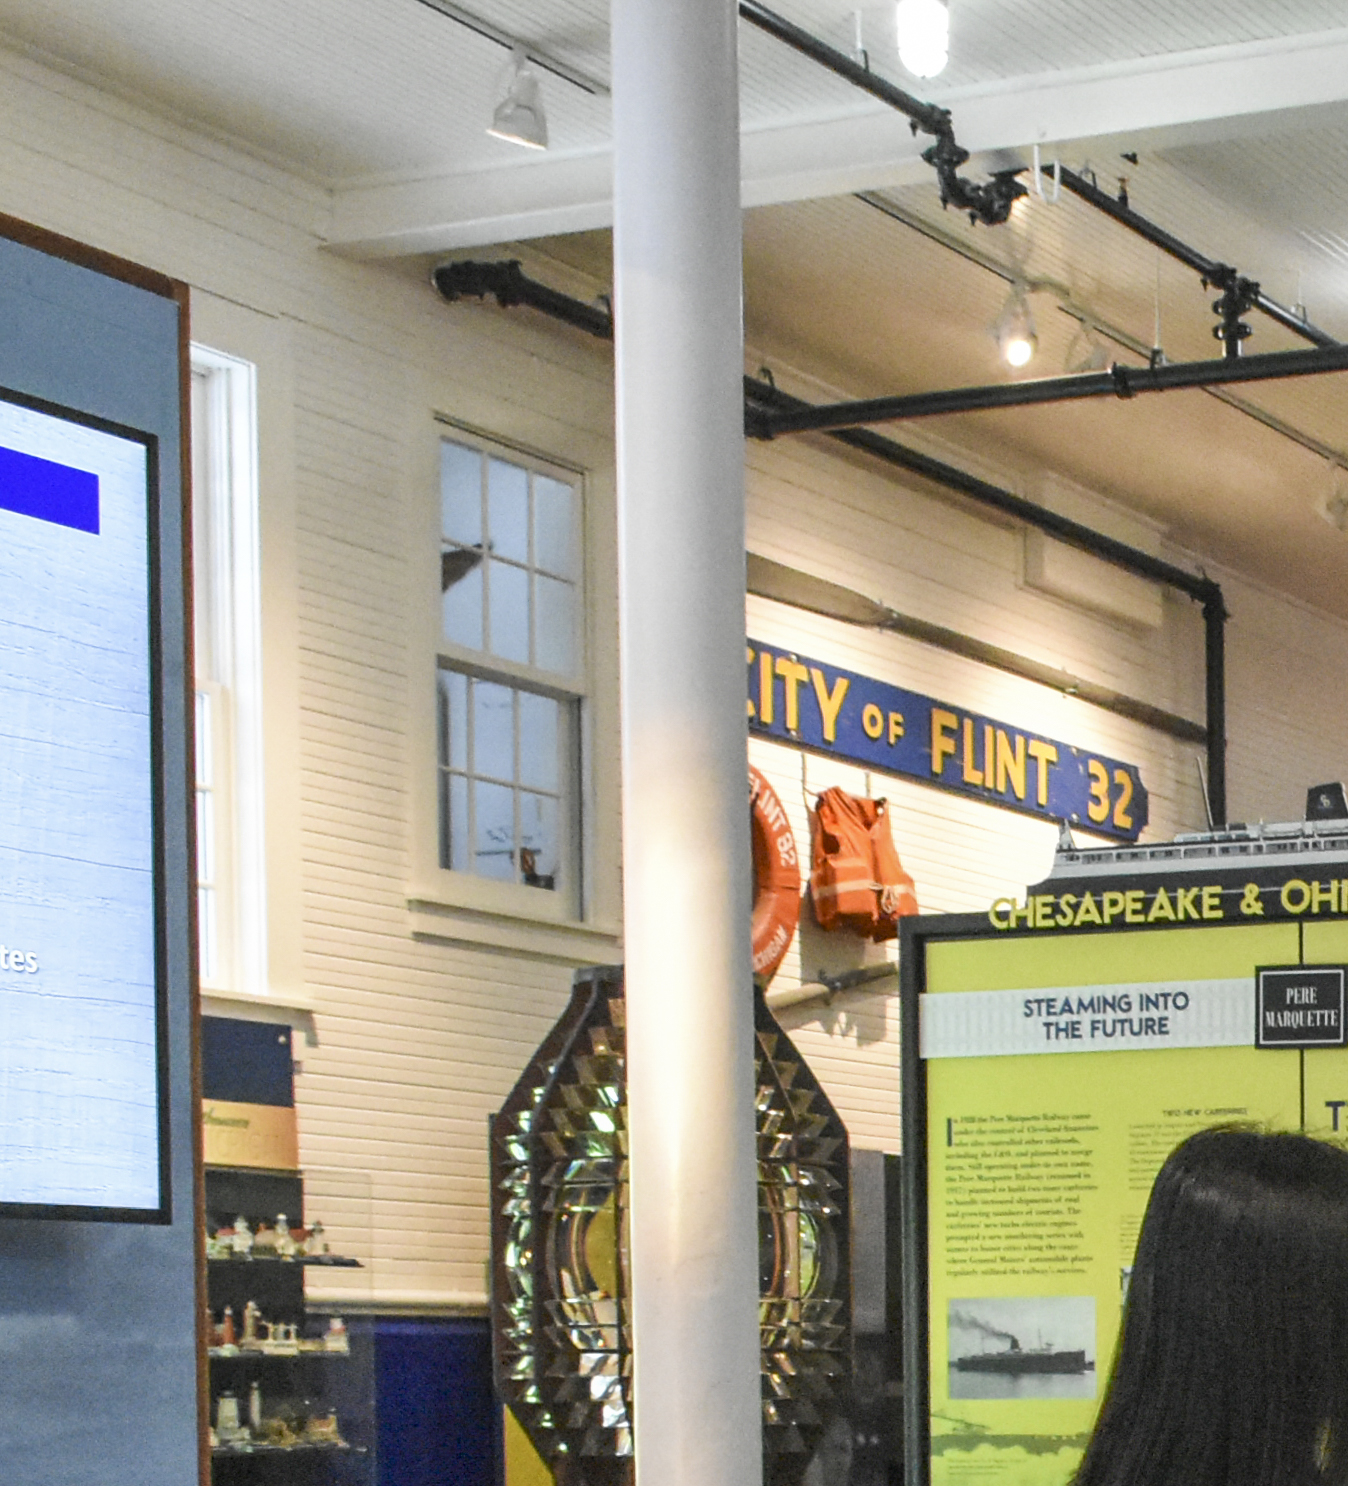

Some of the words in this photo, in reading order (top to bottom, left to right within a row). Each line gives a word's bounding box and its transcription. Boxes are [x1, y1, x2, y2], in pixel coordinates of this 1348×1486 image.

[861, 702, 906, 746] OF
[930, 706, 1058, 808] FLINT
[1087, 758, 1134, 830] 32
[987, 882, 1224, 931] CHESAPEAKE
[1239, 882, 1265, 915] &
[1022, 993, 1132, 1020] STEAMING
[1138, 989, 1190, 1015] INTO
[1283, 984, 1318, 1007] PERE
[1041, 1017, 1084, 1041] THE
[1090, 1013, 1170, 1039] FUTURE
[1264, 1003, 1339, 1030] MARQUETTE
